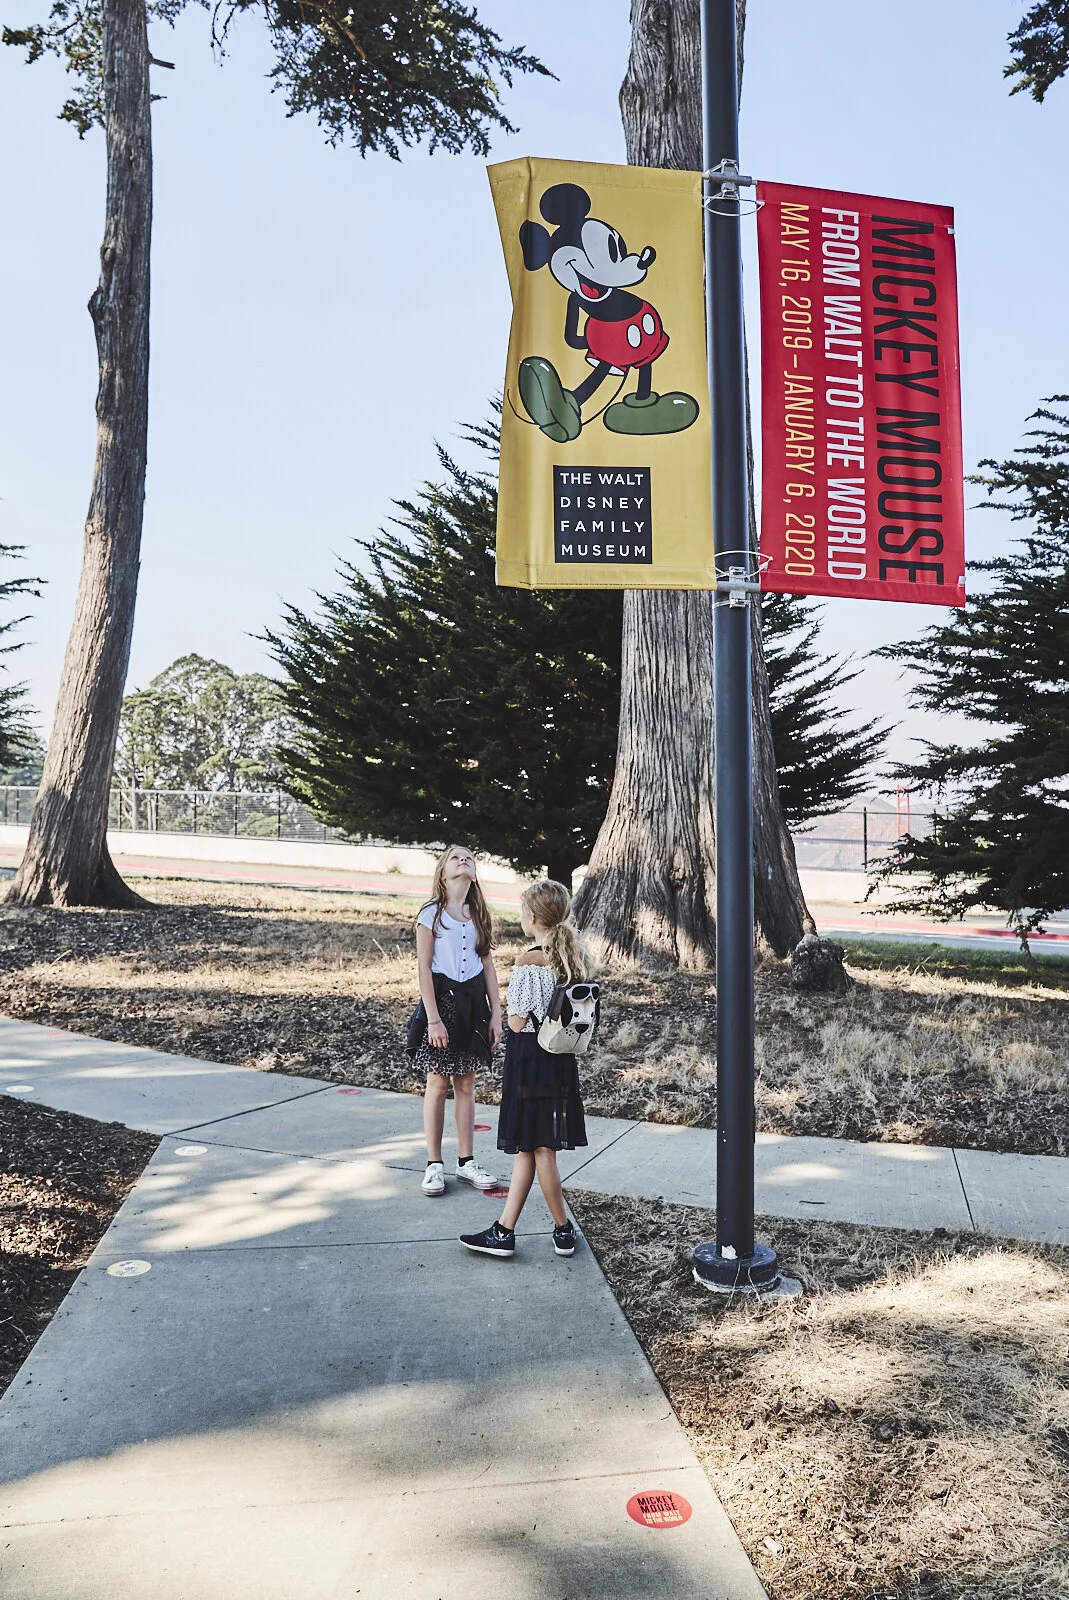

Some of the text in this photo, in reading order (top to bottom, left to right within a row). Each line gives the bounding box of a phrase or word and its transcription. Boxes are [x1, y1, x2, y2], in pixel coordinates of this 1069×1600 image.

[780, 202, 810, 251] MAY
[779, 259, 811, 287] 16,
[822, 207, 867, 580] FROM WALT TO THE WORLD
[872, 214, 944, 586] MICKEY MOUSE
[559, 472, 644, 486] THE WALT
[783, 482, 816, 504] 6,
[560, 496, 644, 509] DISNEY
[560, 520, 645, 533] FAMILY
[561, 544, 646, 557] MUSEUM
[785, 512, 816, 577] 2020
[637, 1495, 673, 1506] MICKEY
[640, 1503, 678, 1513] MOUSE
